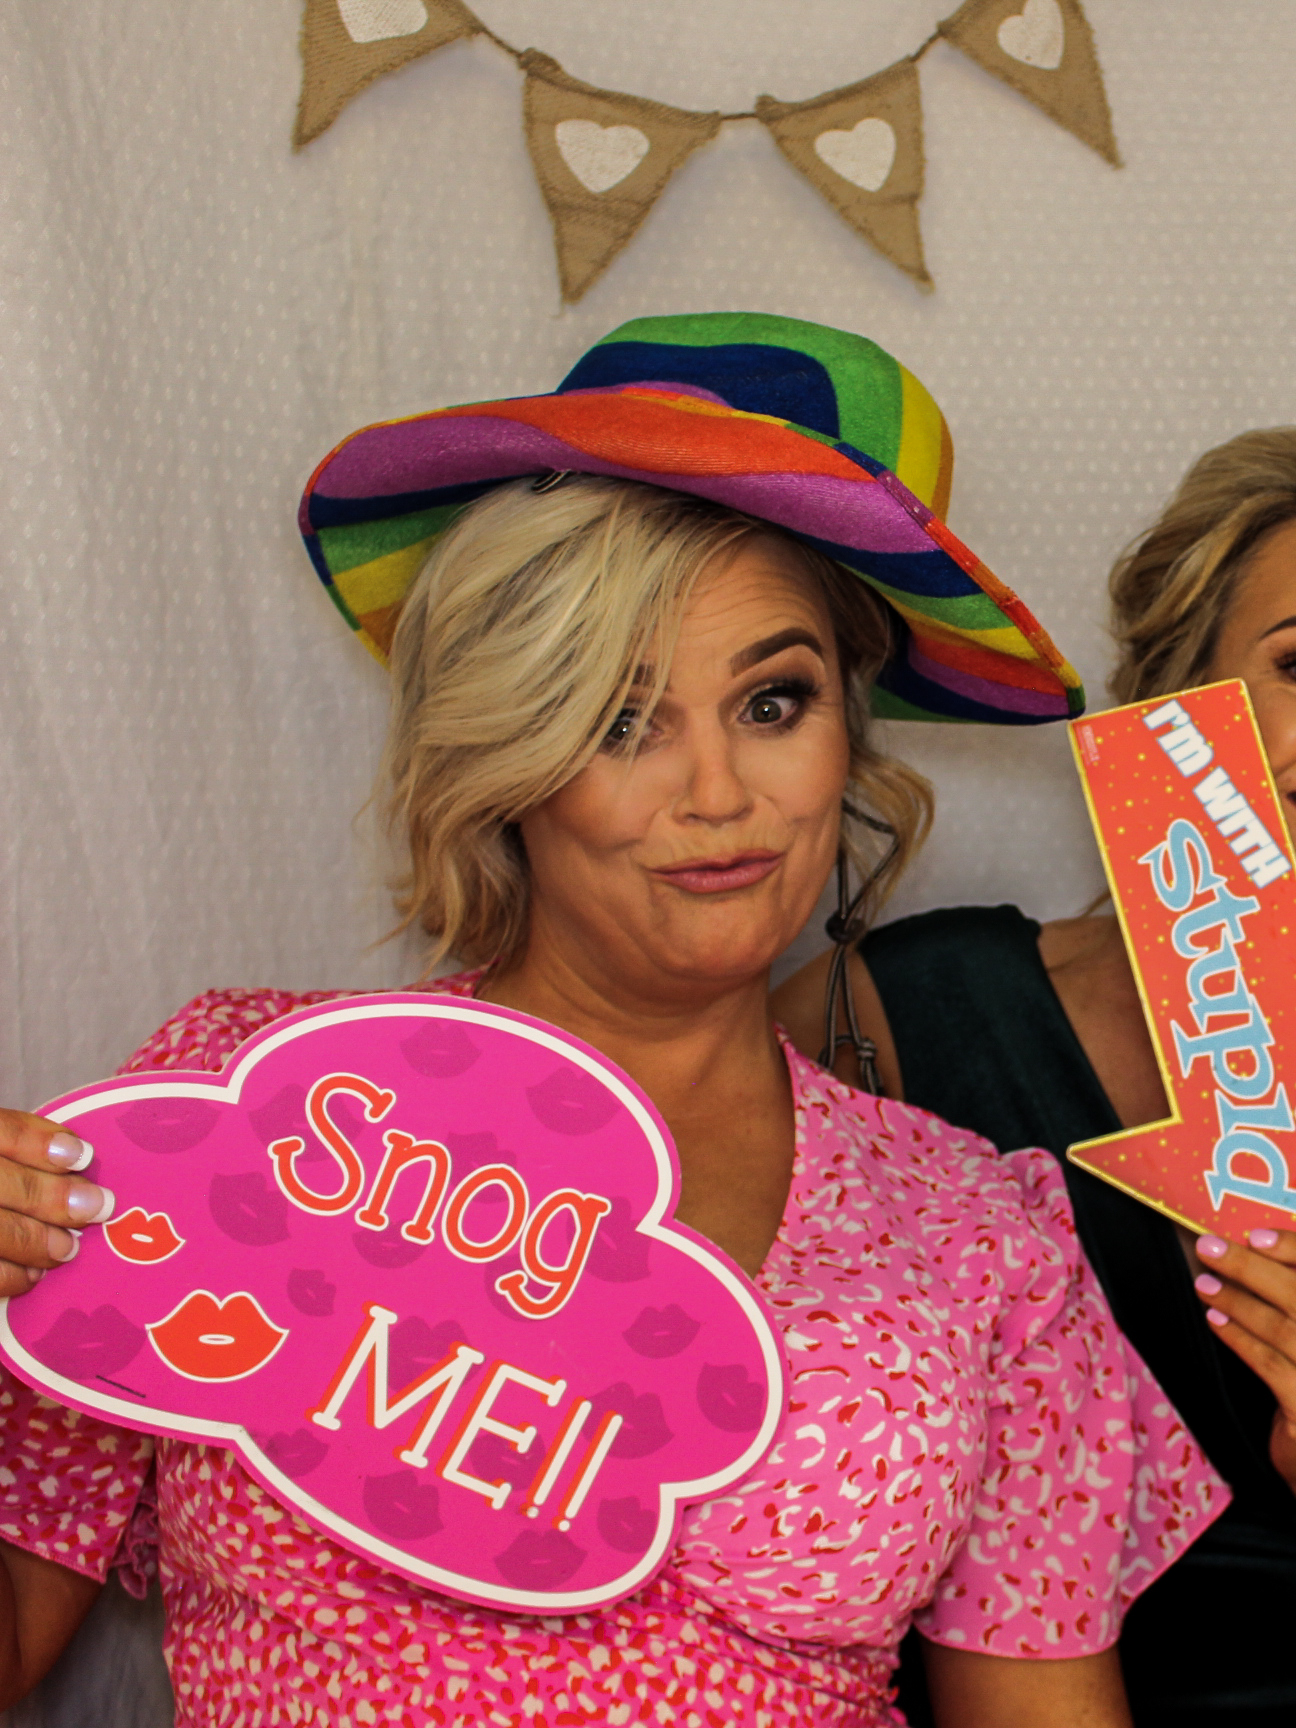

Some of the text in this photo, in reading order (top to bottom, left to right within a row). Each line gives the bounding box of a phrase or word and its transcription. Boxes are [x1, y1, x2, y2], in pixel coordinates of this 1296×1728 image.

[1193, 766, 1293, 889] WITH
[268, 1073, 611, 1320] Snog
[306, 1302, 623, 1532] ME!!
